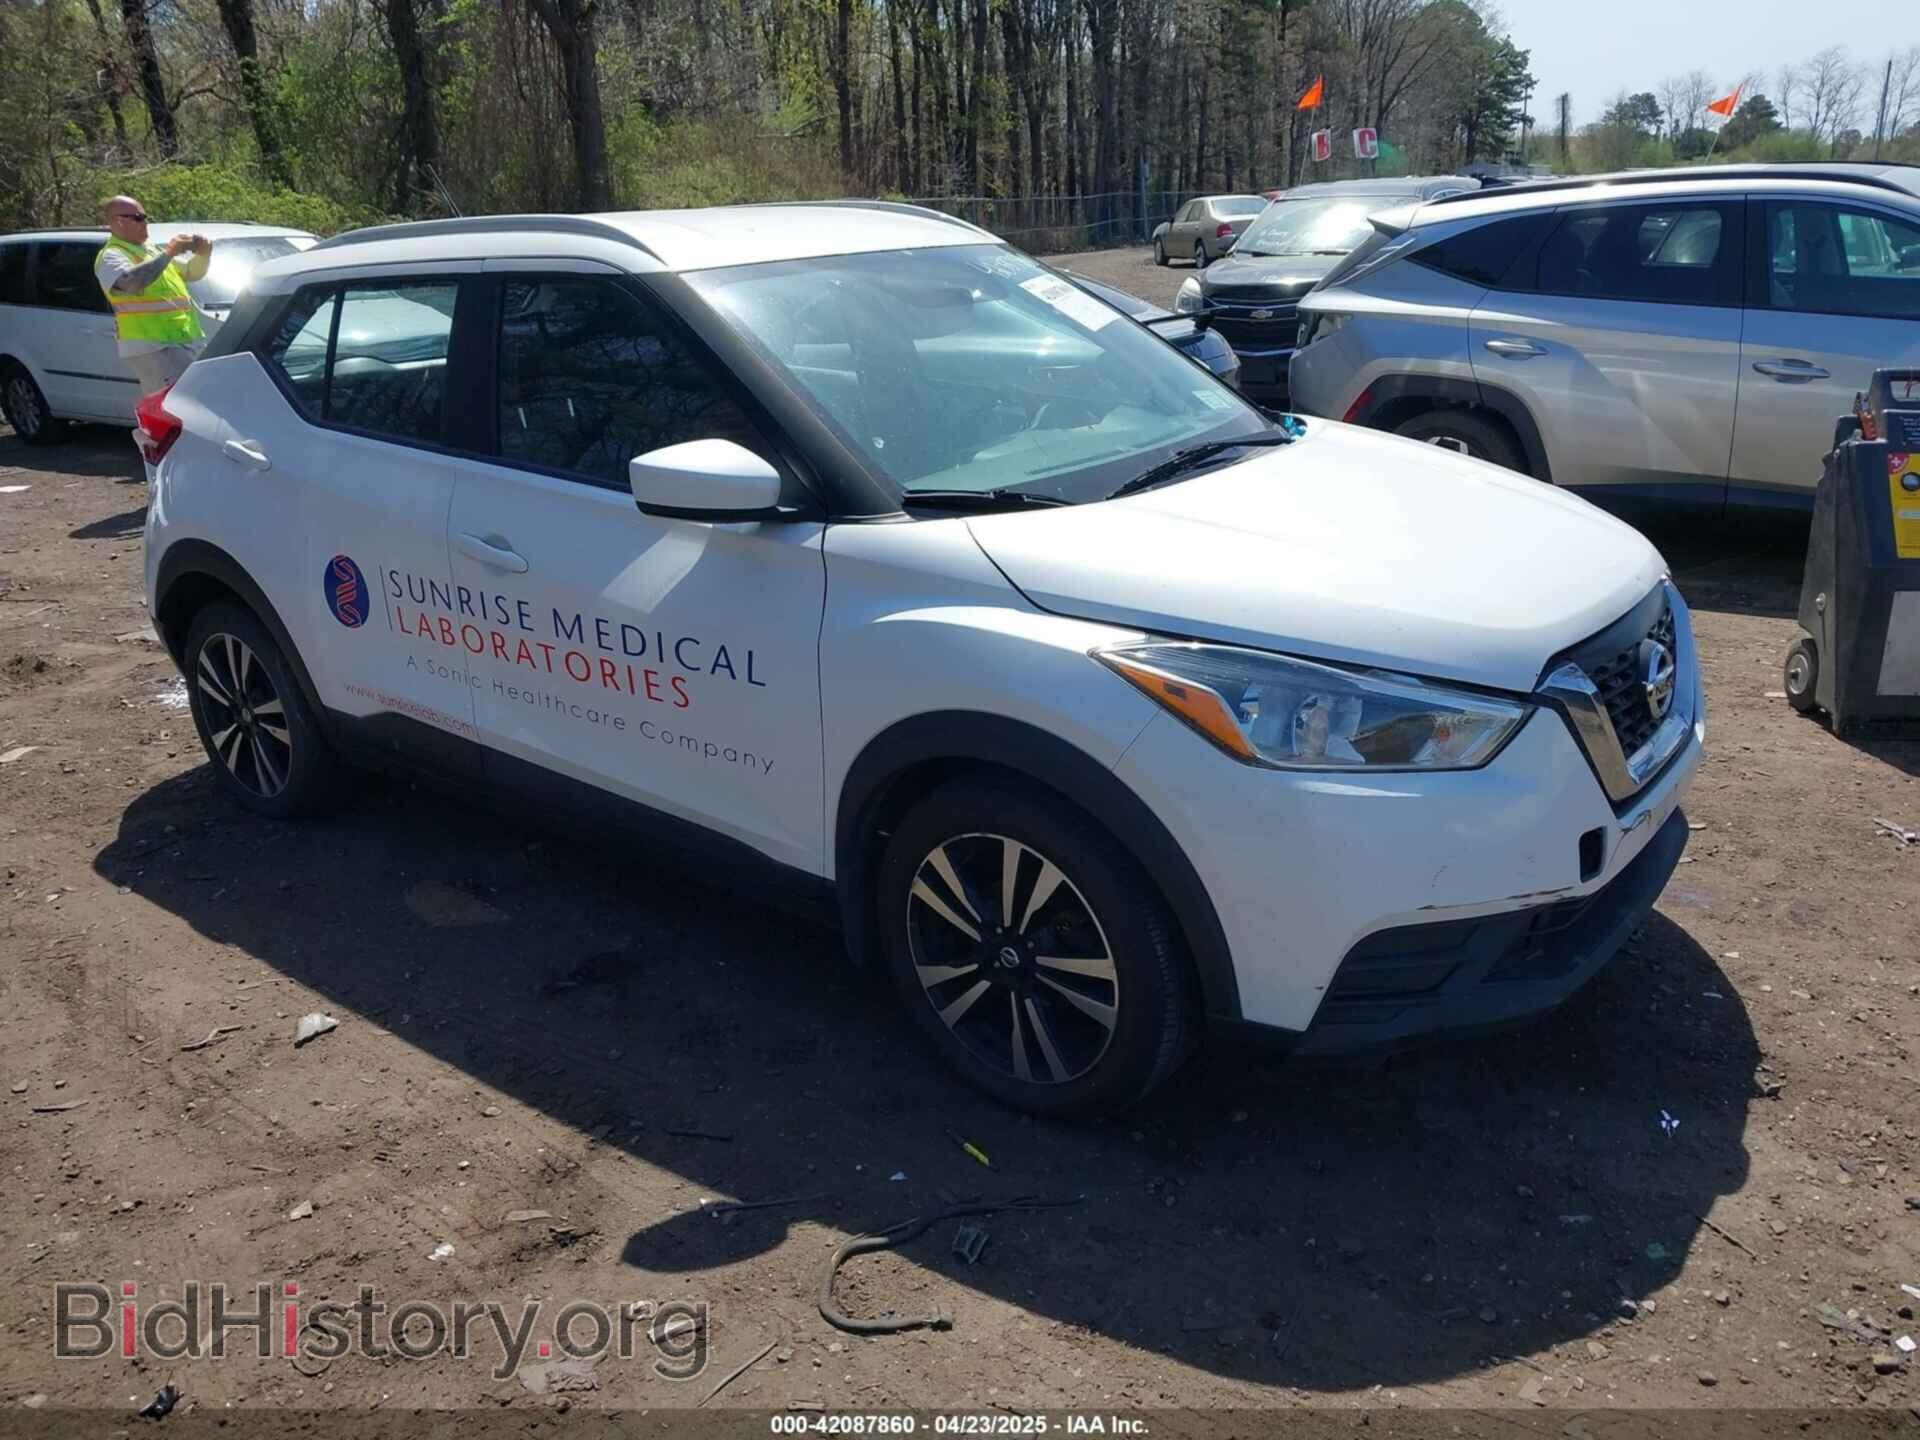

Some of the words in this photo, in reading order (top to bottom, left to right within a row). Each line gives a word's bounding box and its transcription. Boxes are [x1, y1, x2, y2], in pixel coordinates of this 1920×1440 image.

[389, 570, 535, 632] SUNRISE
[552, 608, 766, 687] MEDICAL
[396, 606, 690, 708] LABORATORIES
[406, 655, 419, 671] A
[424, 659, 483, 689] Sonic
[492, 679, 626, 730] Healthcare
[639, 720, 775, 775] Company
